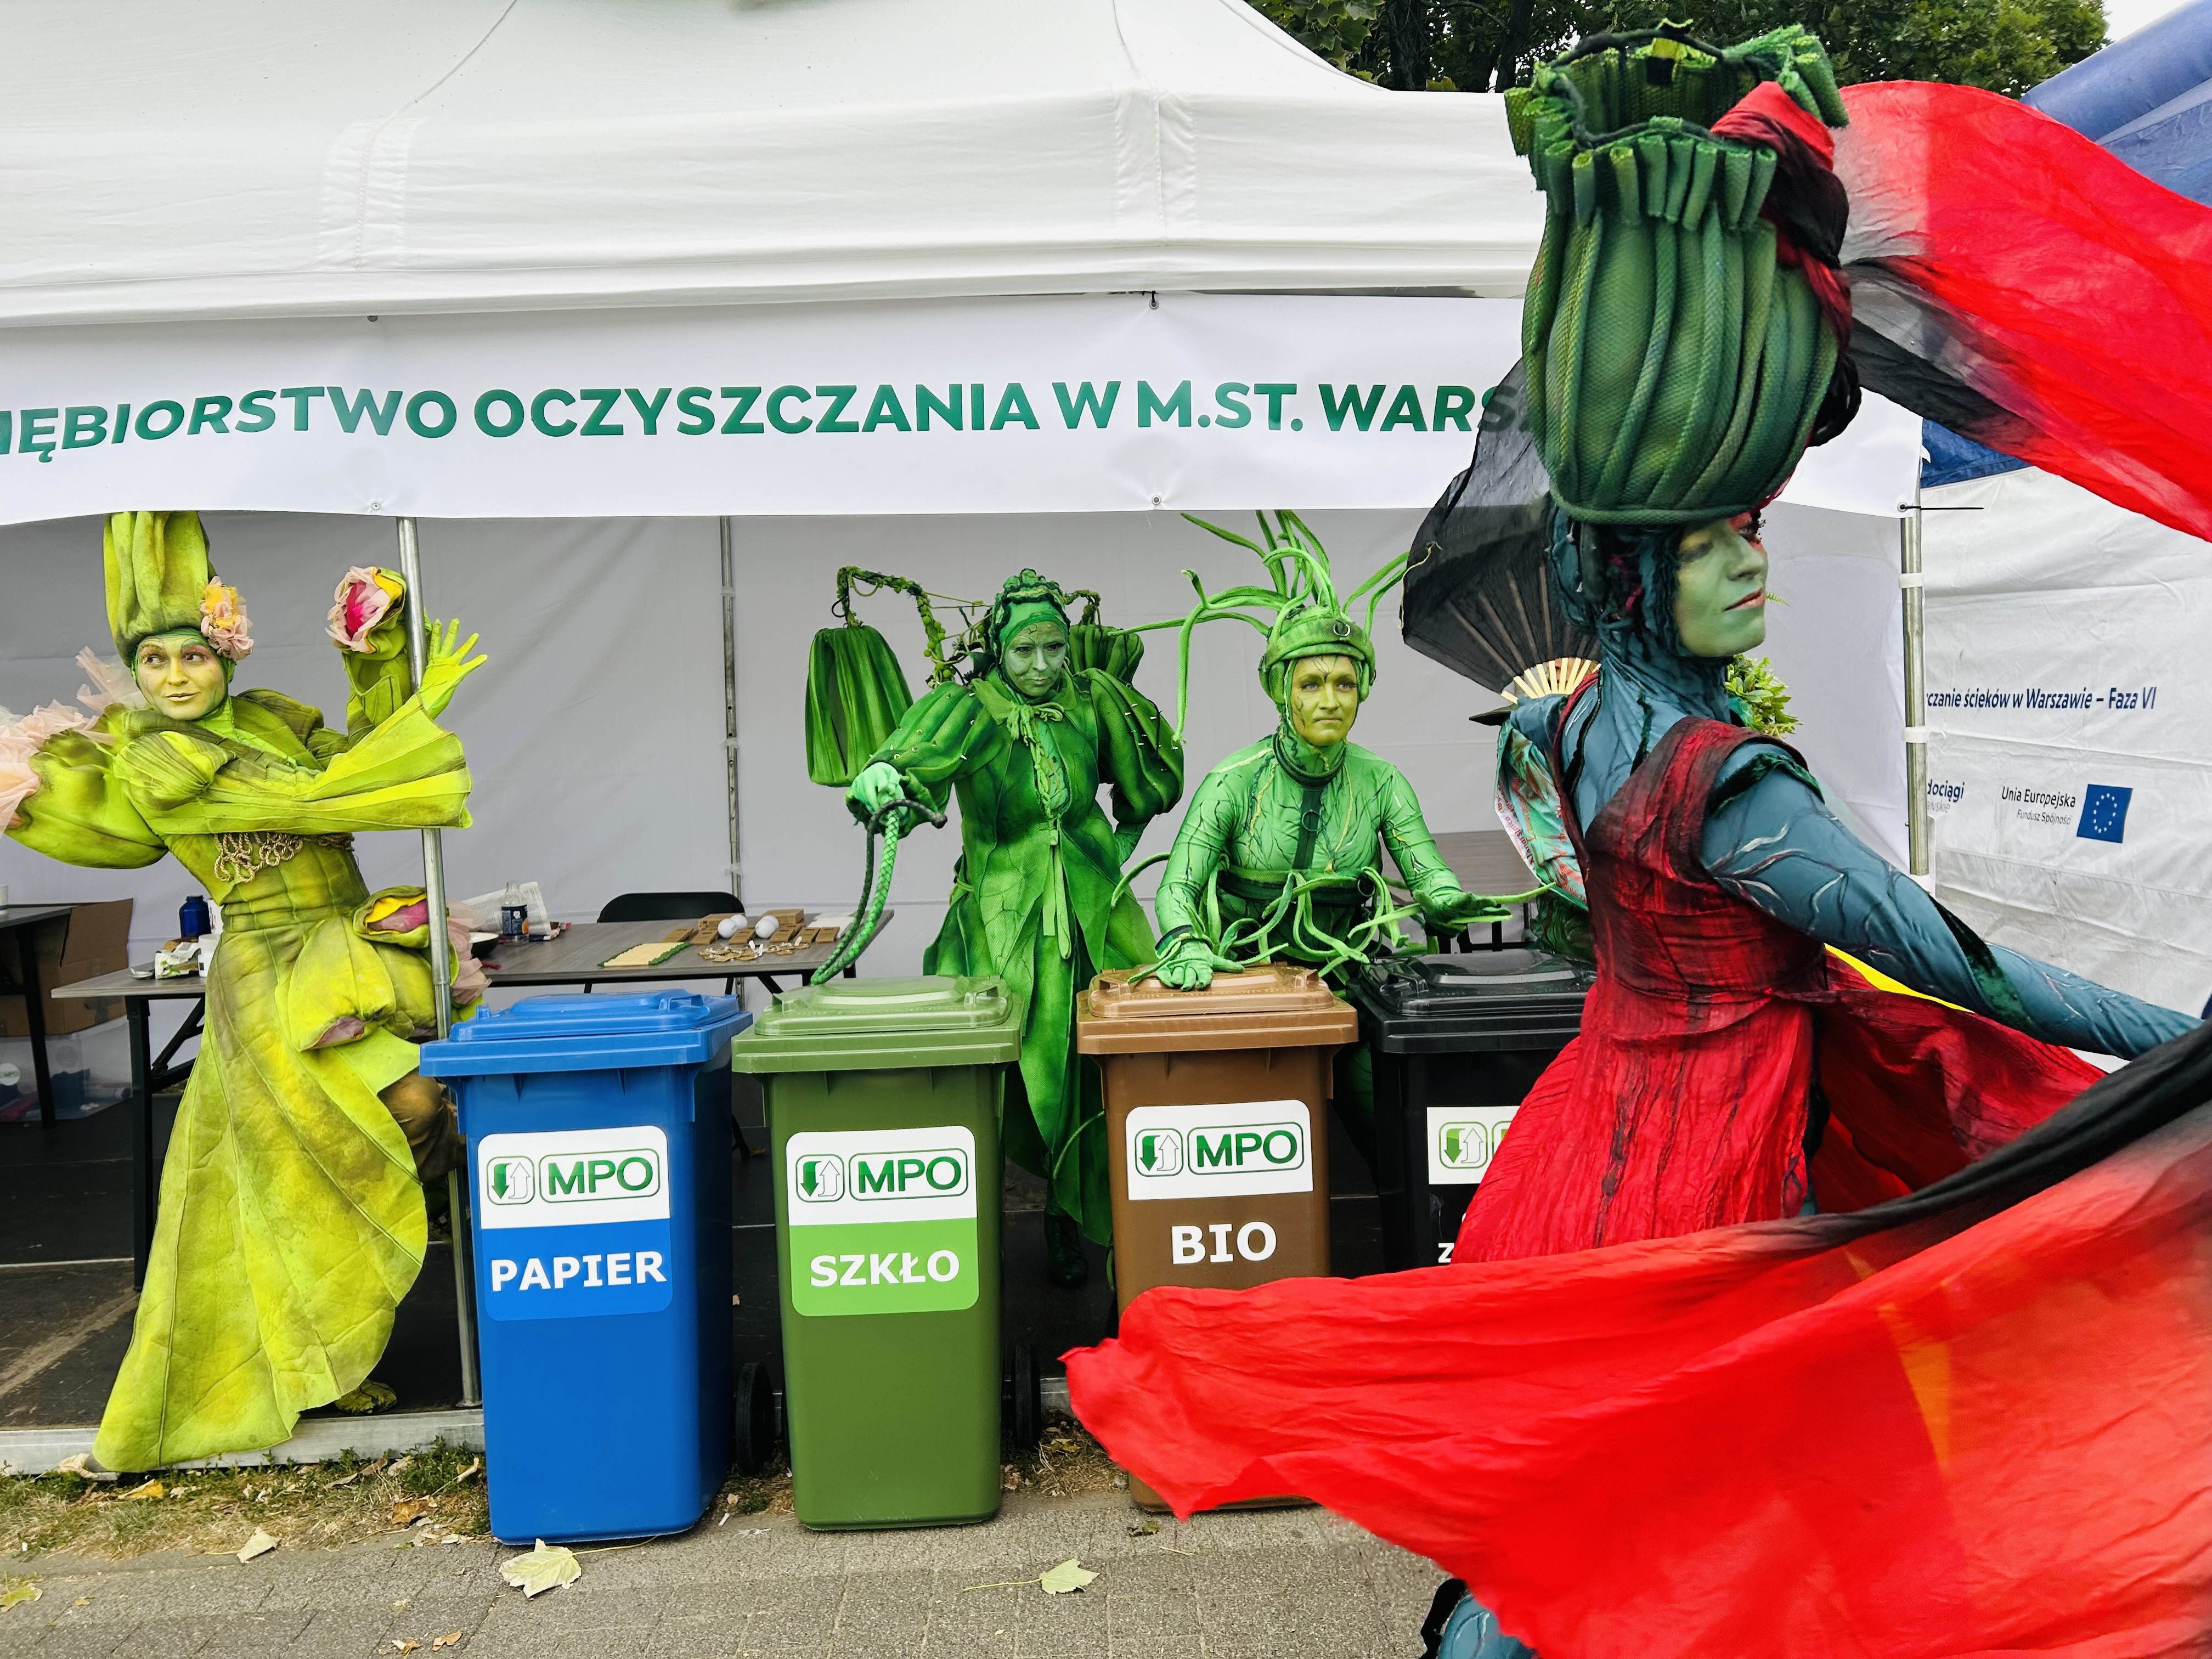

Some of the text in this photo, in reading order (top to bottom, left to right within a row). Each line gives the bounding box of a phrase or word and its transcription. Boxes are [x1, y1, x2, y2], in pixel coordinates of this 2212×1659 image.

[0, 381, 1530, 463] IĘBIORSTWO OCZYSZCZANIA W M.ST. WARS
[1926, 687, 1961, 707] czanie
[1963, 687, 2011, 708] ścieków
[2013, 693, 2024, 708] w
[2027, 687, 2093, 709] Warszawie
[2109, 687, 2138, 709] Faza
[2143, 686, 2157, 709] VI
[2002, 786, 2076, 809] Unia Europejska
[2017, 809, 2072, 825] Fundusz Spójności
[1196, 1130, 1297, 1167] MPO
[549, 1156, 653, 1195] MPO
[859, 1156, 962, 1193] MPO
[1171, 1221, 1277, 1265] BIO
[491, 1251, 667, 1291] PAPIER
[810, 1250, 960, 1287] SZKŁO
